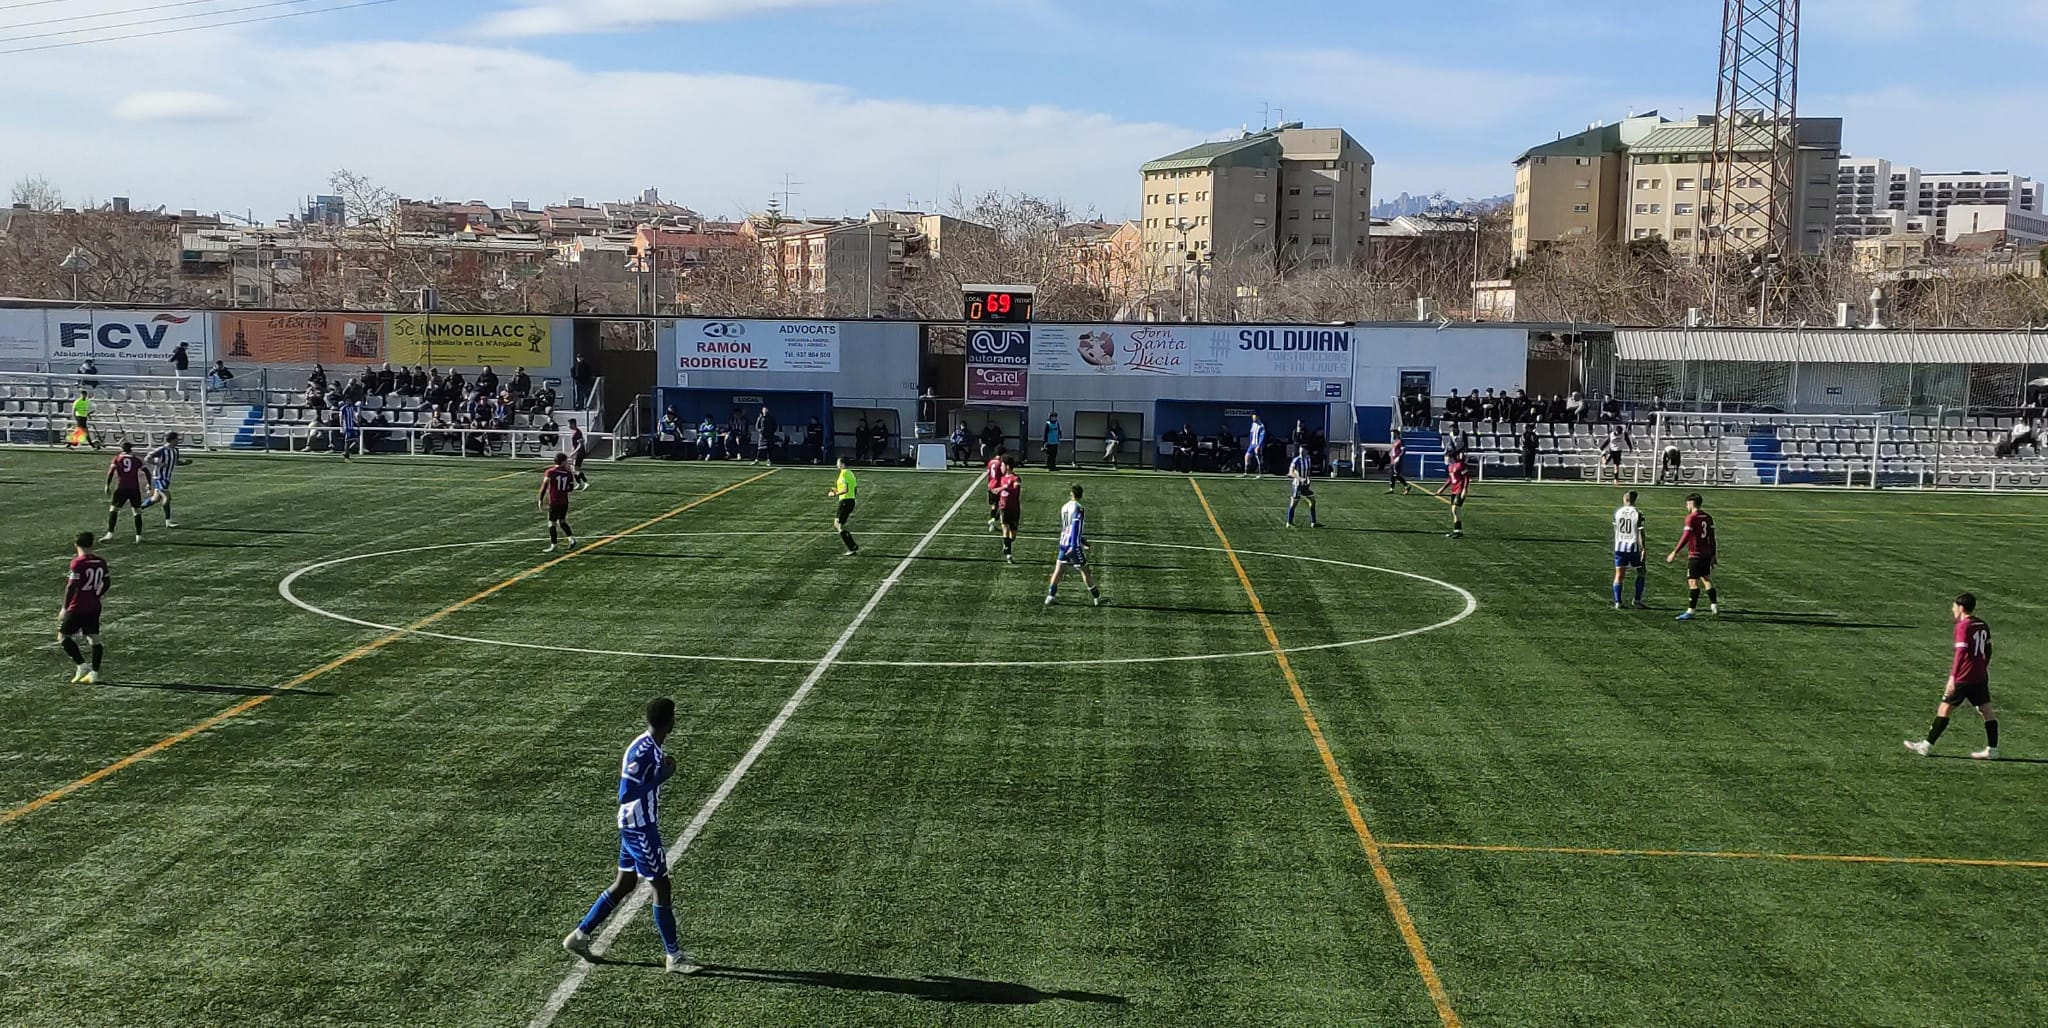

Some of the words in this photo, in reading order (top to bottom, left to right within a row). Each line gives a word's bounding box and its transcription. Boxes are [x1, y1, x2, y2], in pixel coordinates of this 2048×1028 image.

[970, 302, 982, 319] 0
[987, 293, 1011, 312] 69
[1025, 304, 1031, 320] 1
[60, 323, 168, 349] FCV
[420, 324, 524, 337] INMOBILACC
[778, 325, 836, 335] ADVOCATS
[1140, 327, 1171, 339] Forn
[696, 340, 751, 353] RAMÓN
[1123, 331, 1187, 352] Santa
[680, 355, 768, 369] RODRÍGUEZ
[968, 354, 1027, 364] autoramos
[123, 458, 132, 473] 9
[556, 475, 568, 491] 11
[1619, 517, 1632, 534] 20
[1701, 521, 1708, 539] 3
[81, 567, 104, 596] 20
